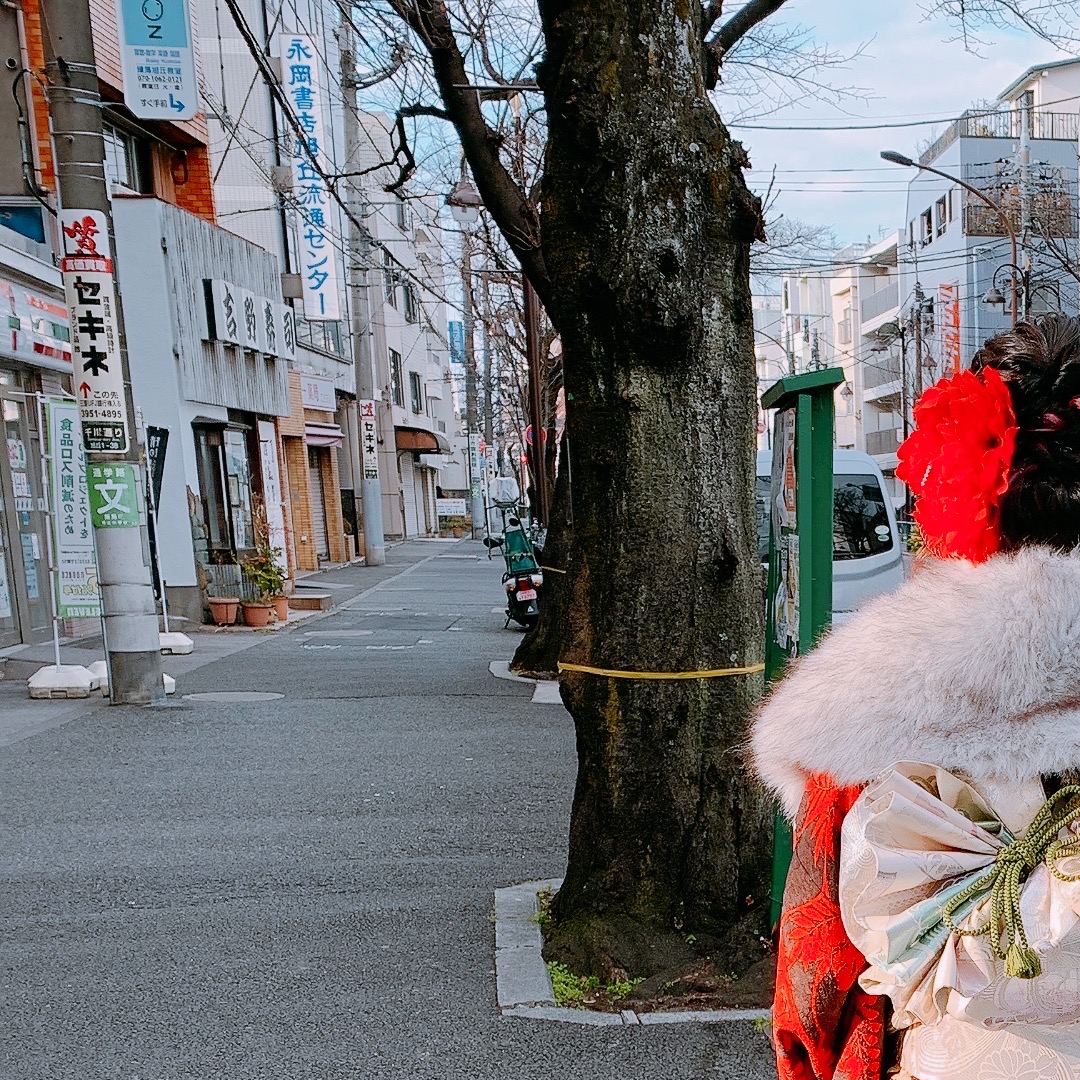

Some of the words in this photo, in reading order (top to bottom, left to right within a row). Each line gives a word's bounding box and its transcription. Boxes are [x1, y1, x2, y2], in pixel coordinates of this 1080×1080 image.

[73, 275, 109, 376] セキネ
[93, 390, 119, 399] この先
[81, 409, 122, 418] 3951-4895
[84, 427, 123, 438] 千川通り
[364, 421, 375, 455] セキネ
[94, 478, 131, 514] 文
